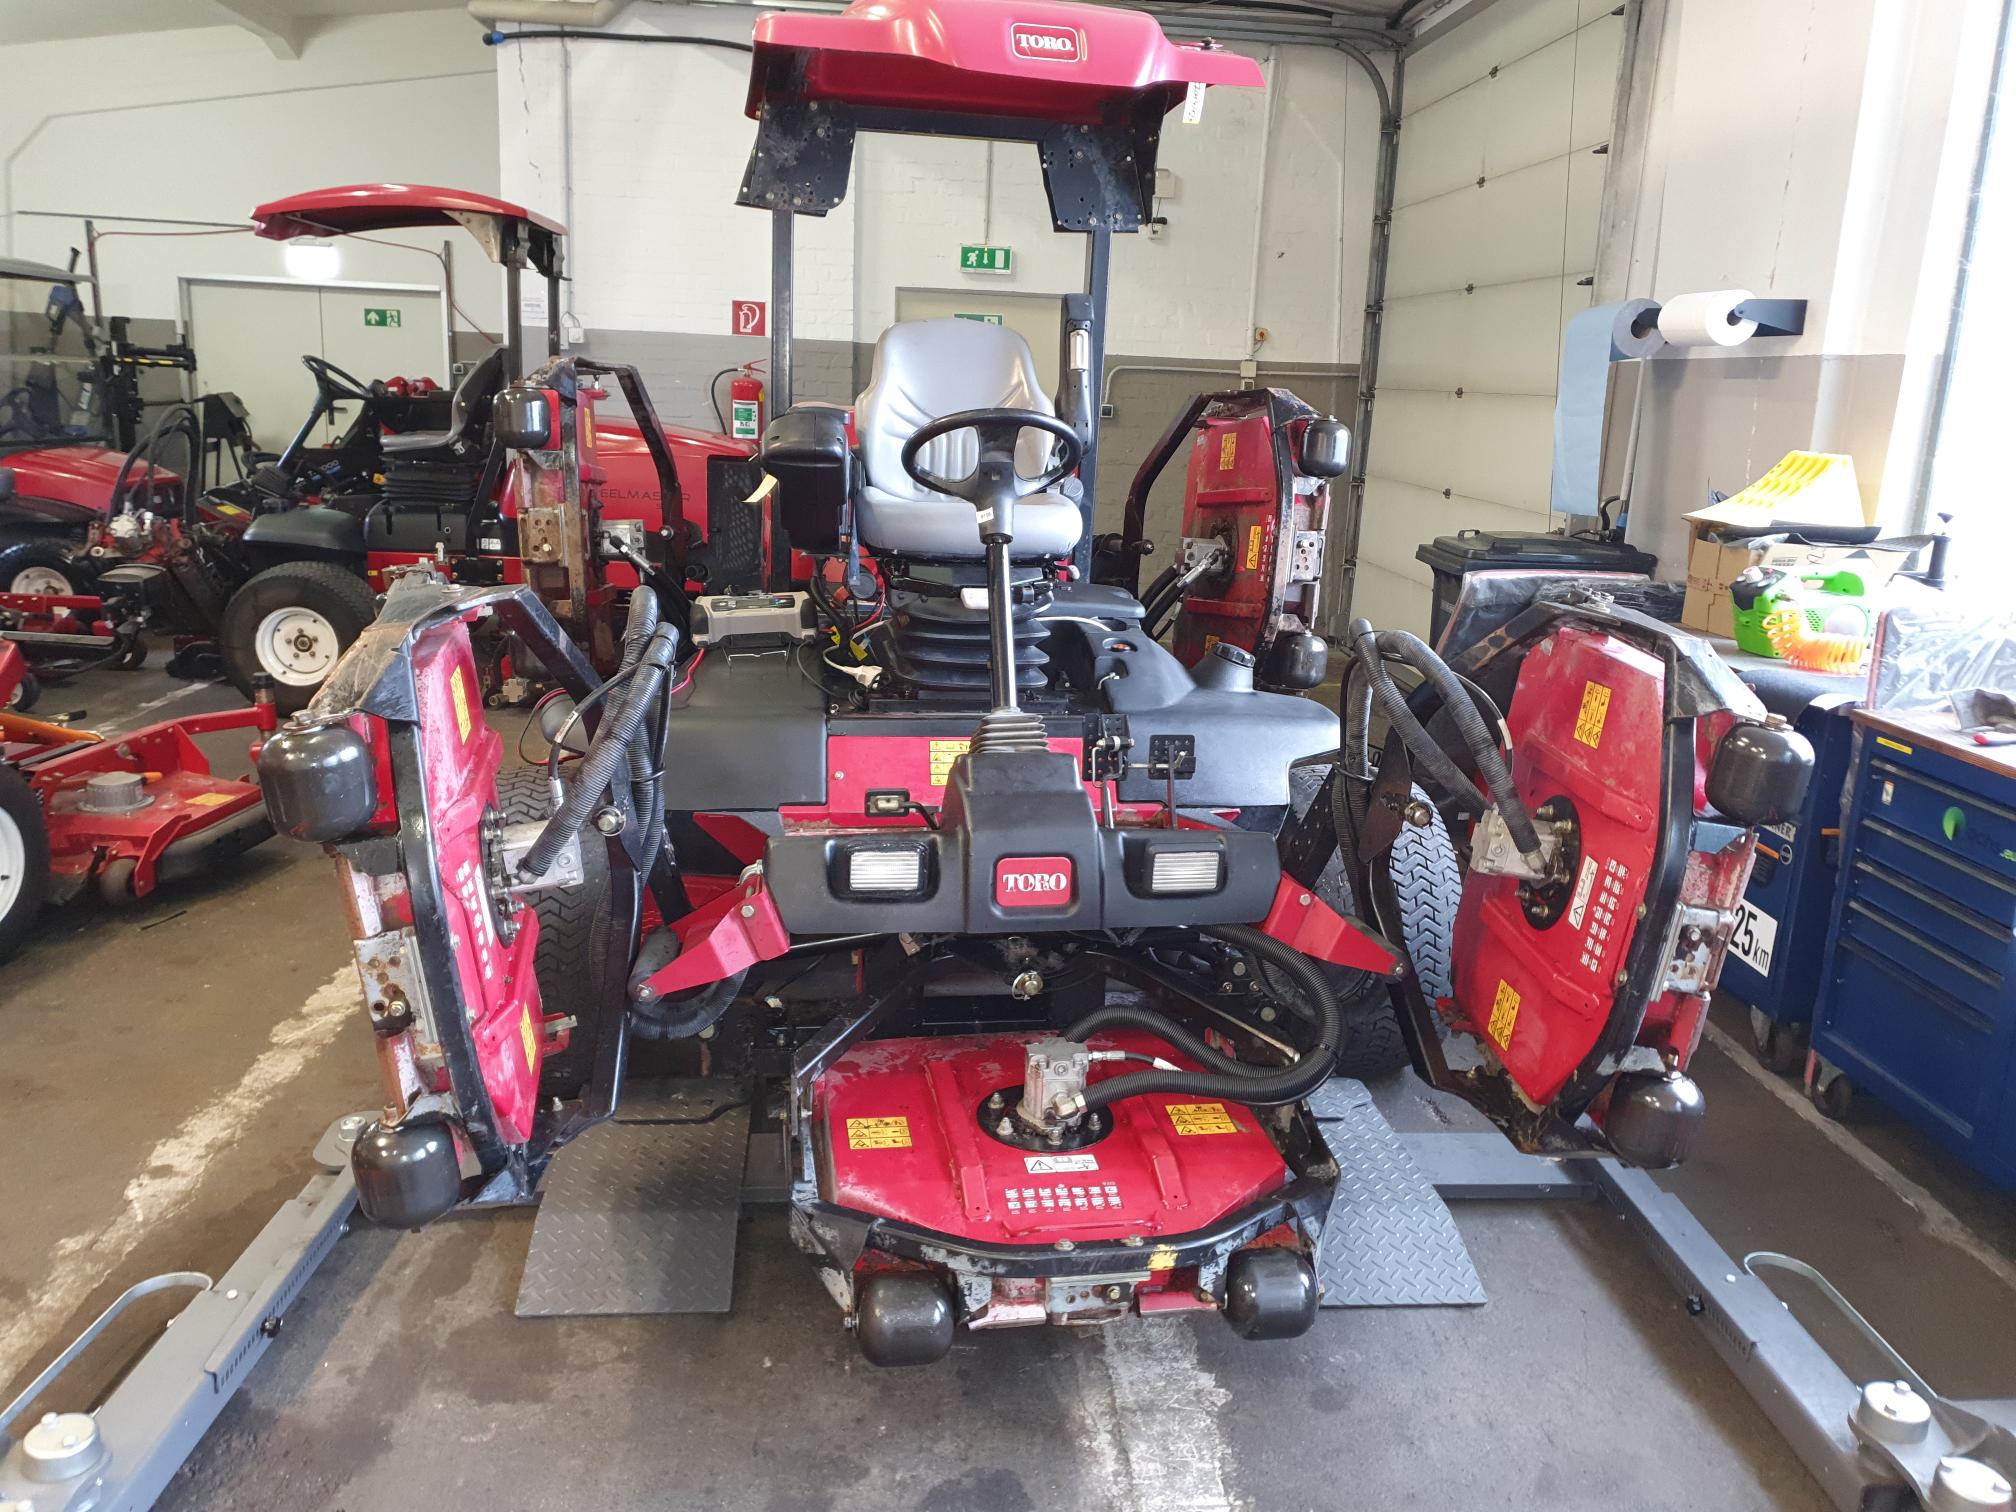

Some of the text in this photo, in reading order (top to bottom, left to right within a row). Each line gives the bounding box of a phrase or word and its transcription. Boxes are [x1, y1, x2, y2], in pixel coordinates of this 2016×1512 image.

[1016, 33, 1072, 51] TORO
[600, 488, 691, 502] EELMASR
[1003, 872, 1067, 893] TORO
[1730, 904, 1770, 971] 25 km
